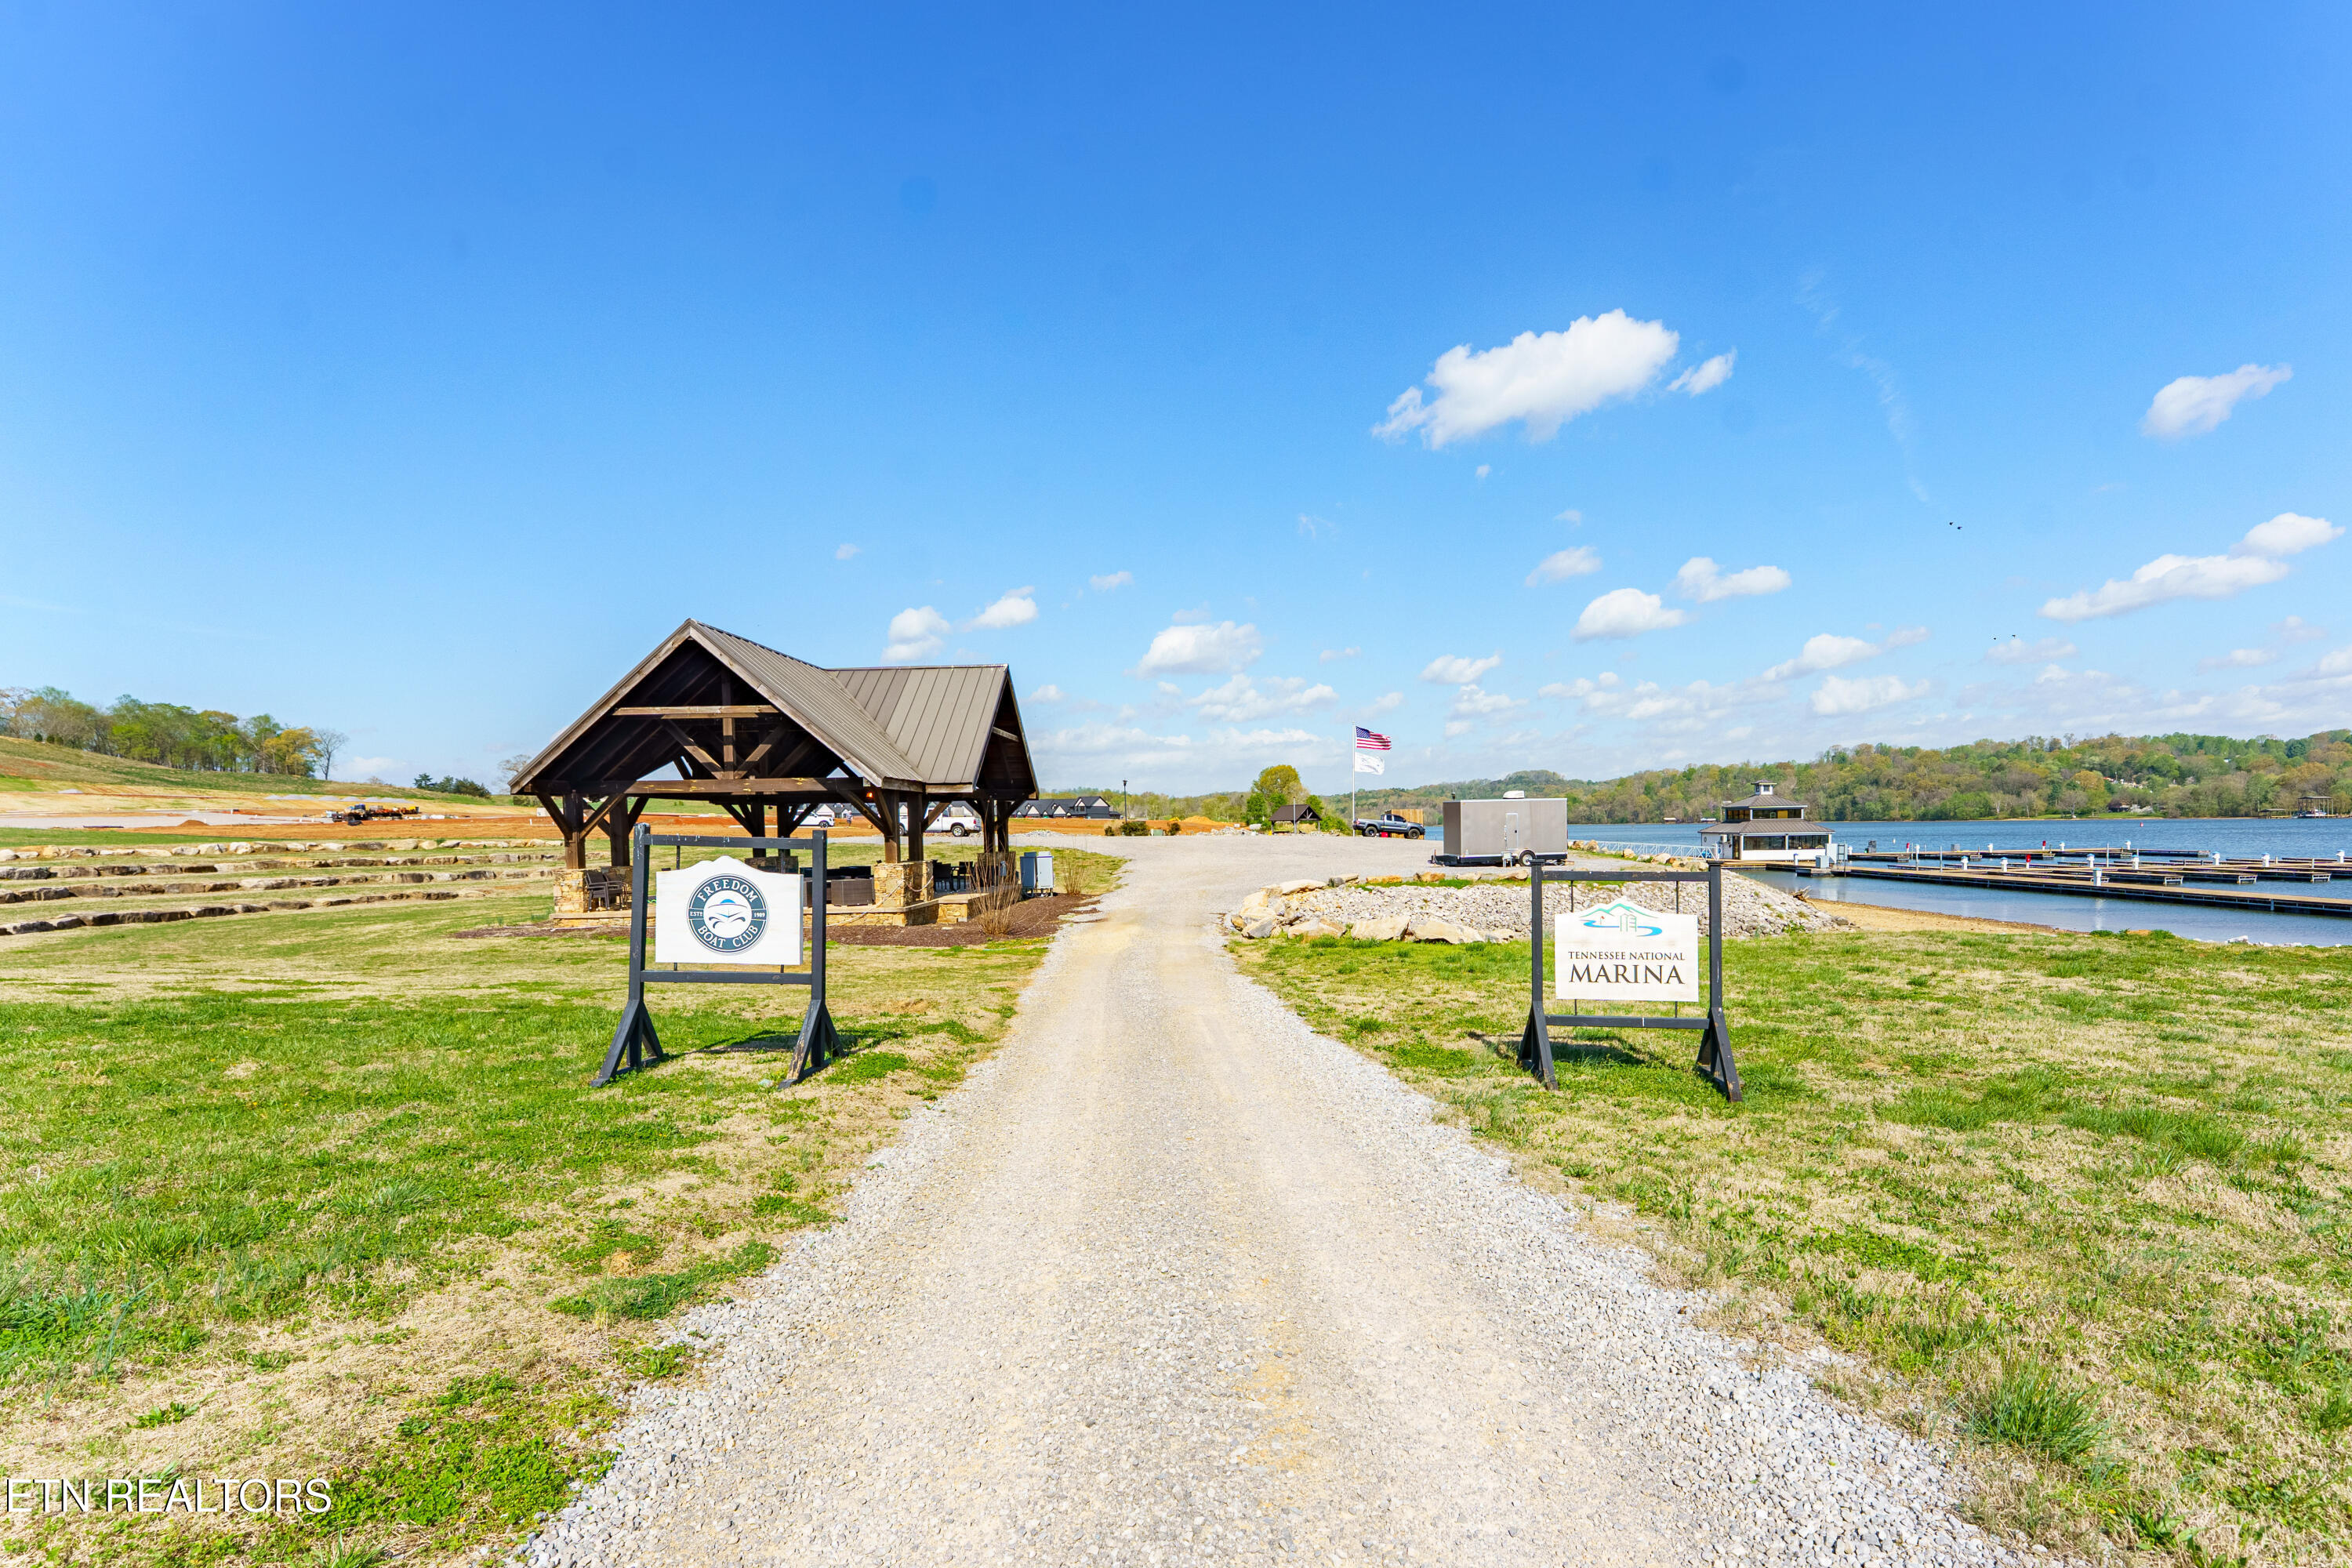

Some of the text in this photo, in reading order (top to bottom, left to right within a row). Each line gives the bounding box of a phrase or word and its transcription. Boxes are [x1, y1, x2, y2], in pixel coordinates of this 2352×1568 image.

[698, 880, 758, 902] FREEDOM
[698, 926, 758, 948] BOAT CLUB
[1568, 951, 1686, 960] TENNESSEE NATIONAL
[1569, 964, 1686, 985] MARINA
